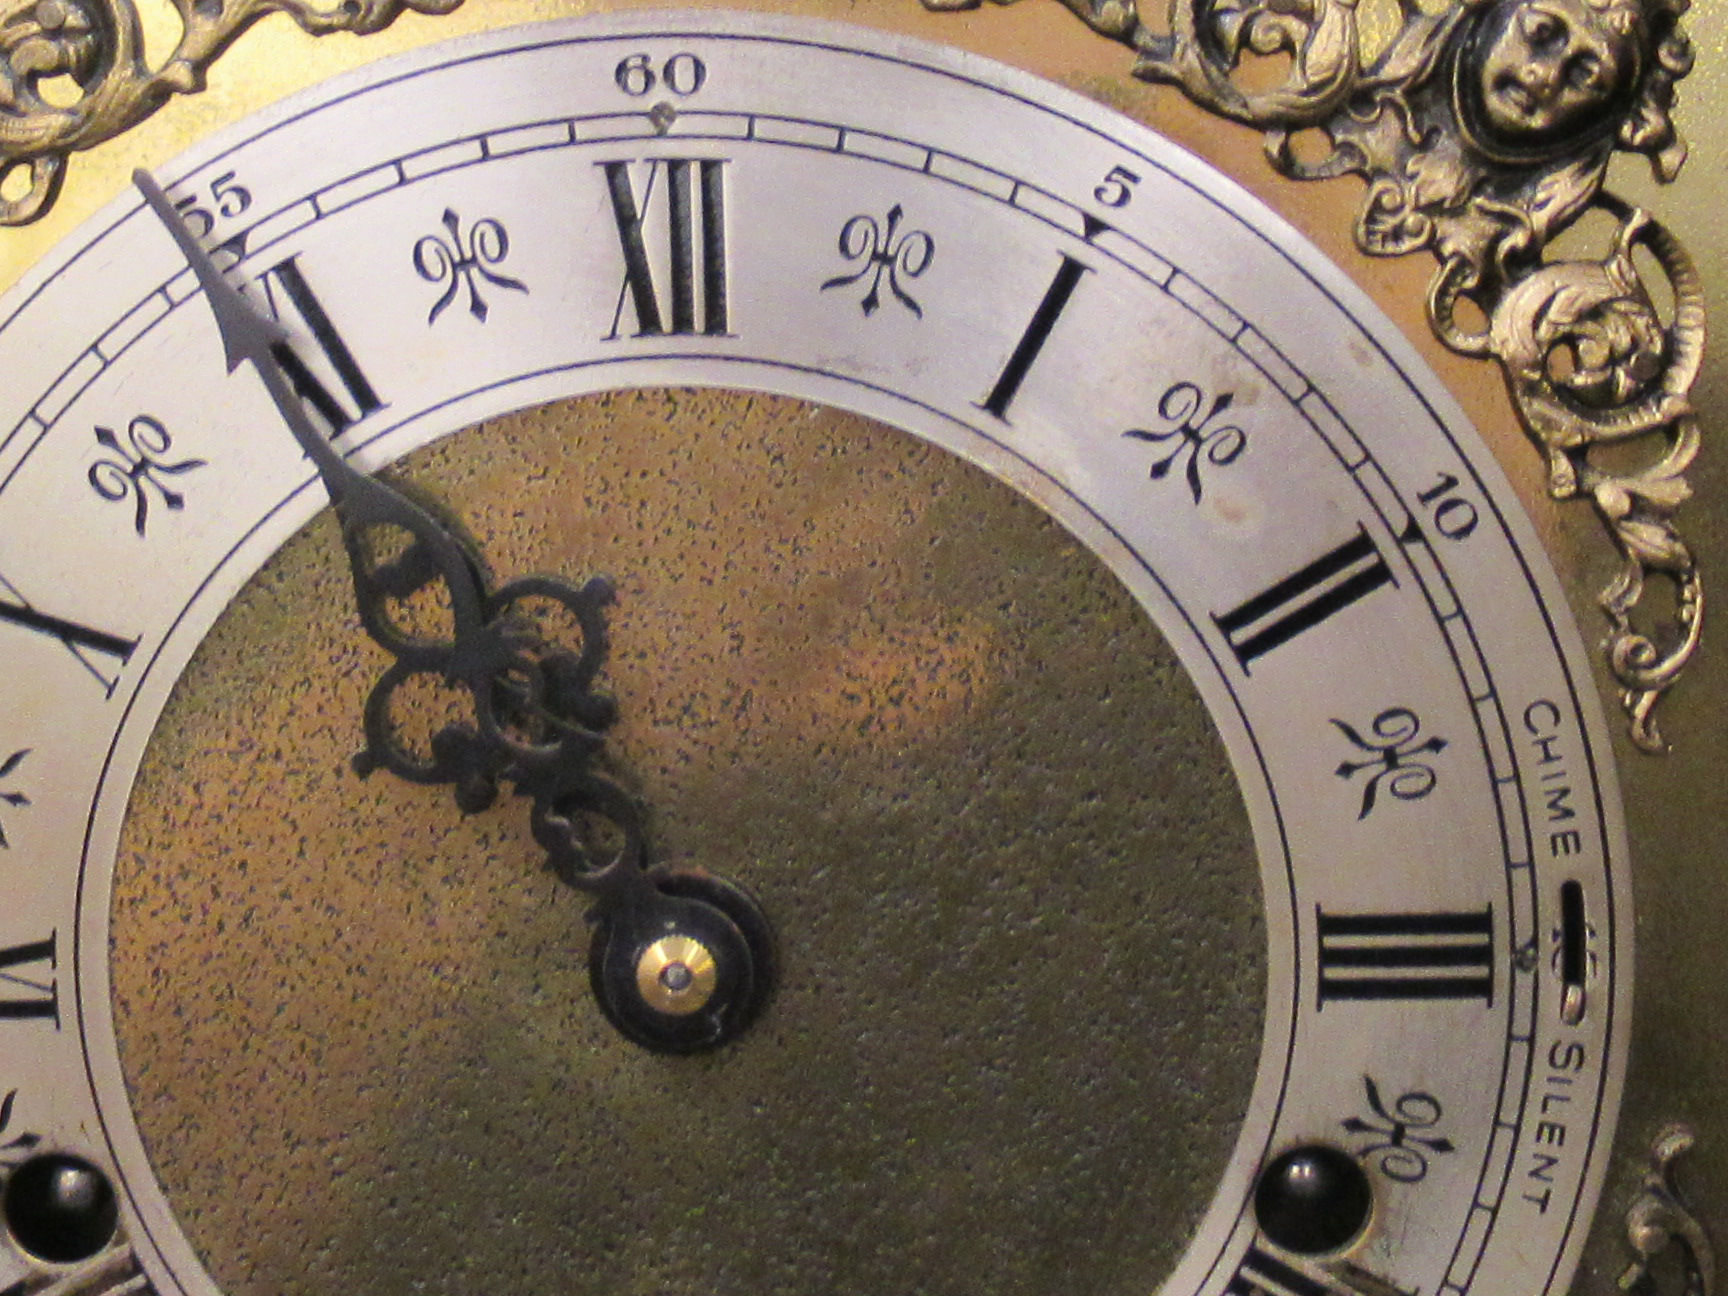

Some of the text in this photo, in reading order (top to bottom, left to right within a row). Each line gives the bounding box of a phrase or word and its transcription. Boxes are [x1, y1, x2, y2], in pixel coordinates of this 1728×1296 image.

[615, 53, 707, 96] 60
[593, 158, 740, 341] XII
[1093, 164, 1142, 207] 5
[969, 249, 1097, 426] I
[1416, 470, 1479, 541] 10
[1209, 519, 1400, 677] II
[1523, 699, 1582, 858] CHIME
[1315, 901, 1494, 1012] III
[1521, 1040, 1584, 1214] SILENT
